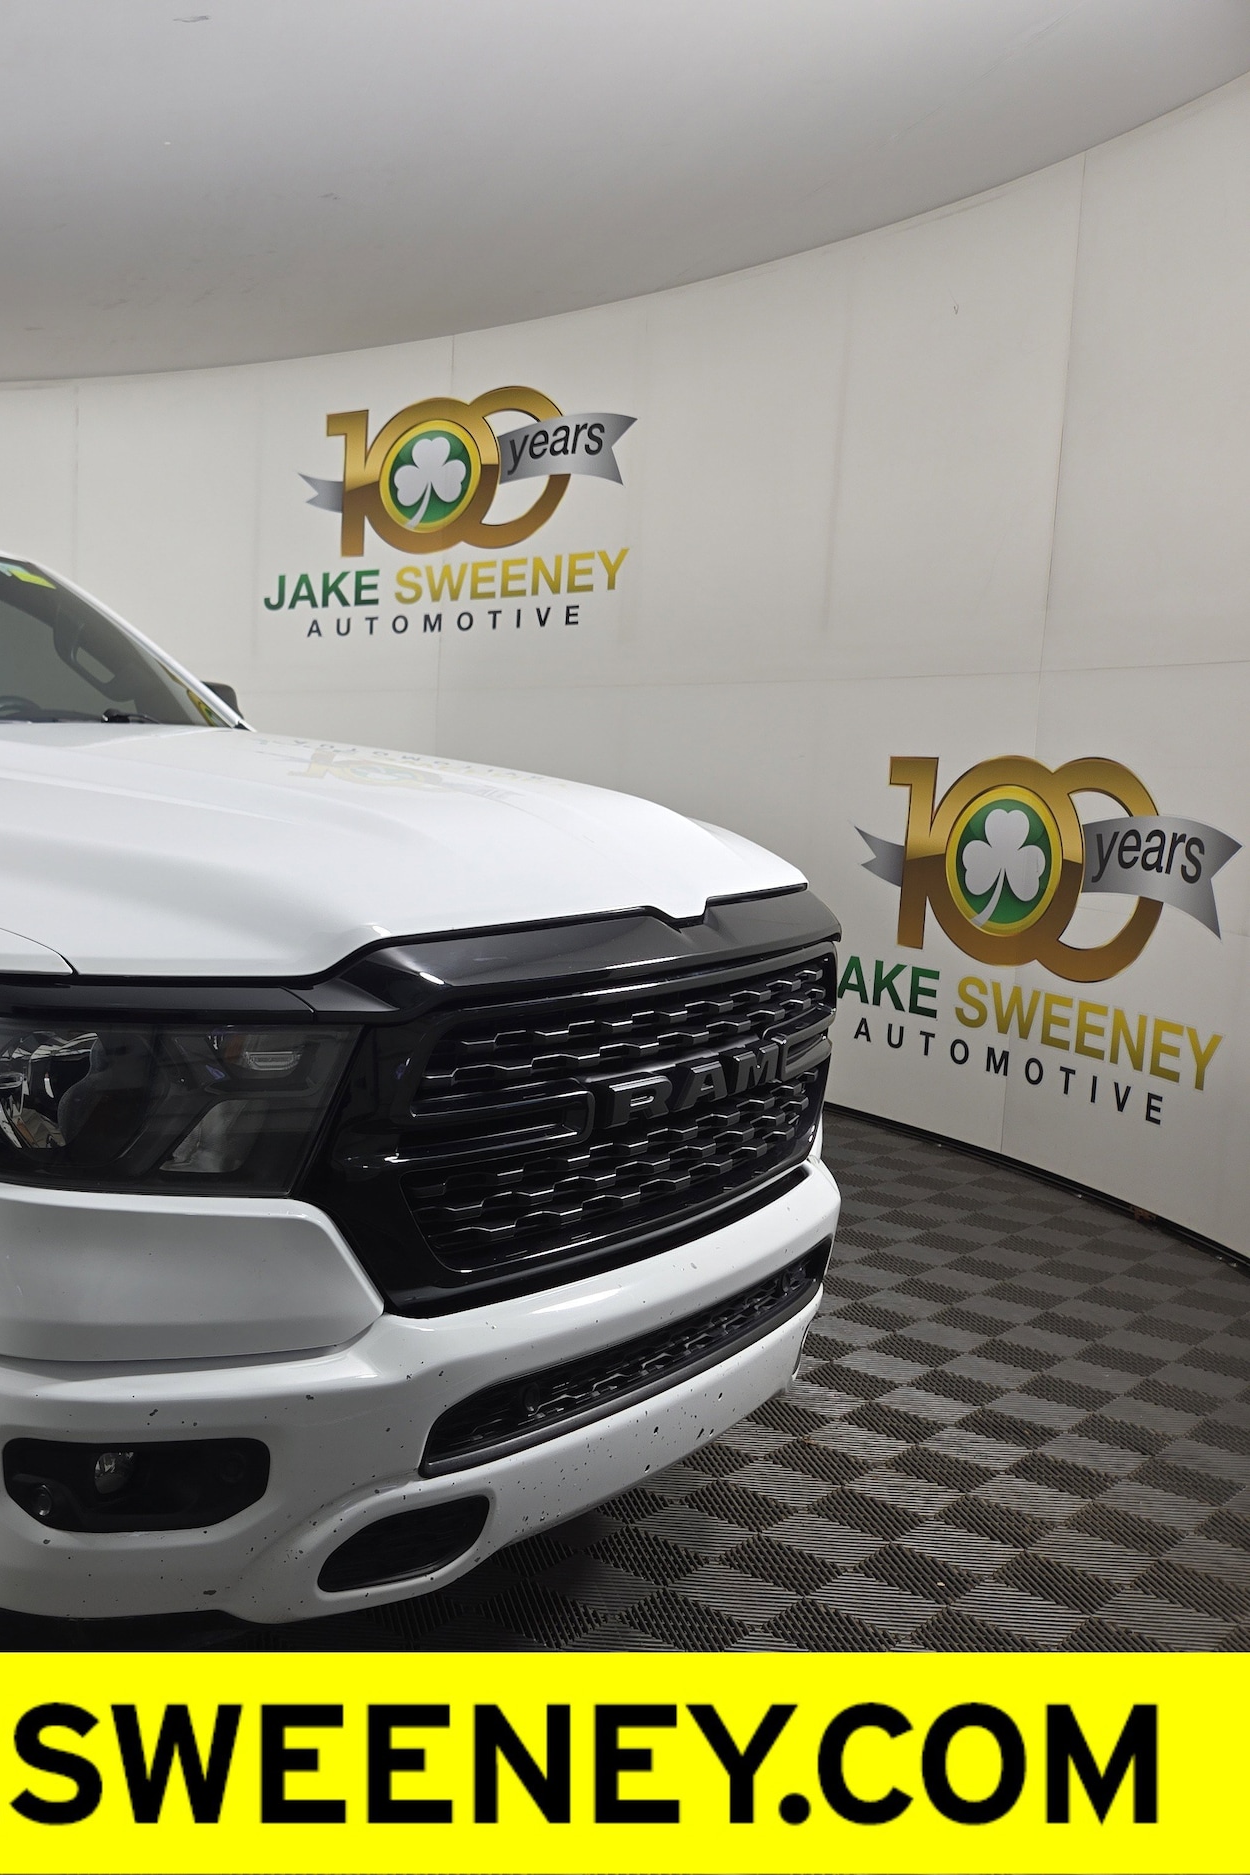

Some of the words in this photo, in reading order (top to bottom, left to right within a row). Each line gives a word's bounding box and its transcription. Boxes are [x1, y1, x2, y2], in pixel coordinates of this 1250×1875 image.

[326, 385, 572, 558] 100
[506, 420, 605, 476] years
[263, 569, 380, 611] JAKE
[394, 548, 630, 605] SWEENEY
[306, 605, 580, 638] AUTOMOTIVE
[888, 754, 1164, 984] 100
[1091, 828, 1205, 884] years
[837, 955, 941, 1019] AKE
[954, 975, 1223, 1091] SWEENEY
[605, 1041, 780, 1128] RAM
[854, 1017, 1163, 1125] AUTOMOTIVE
